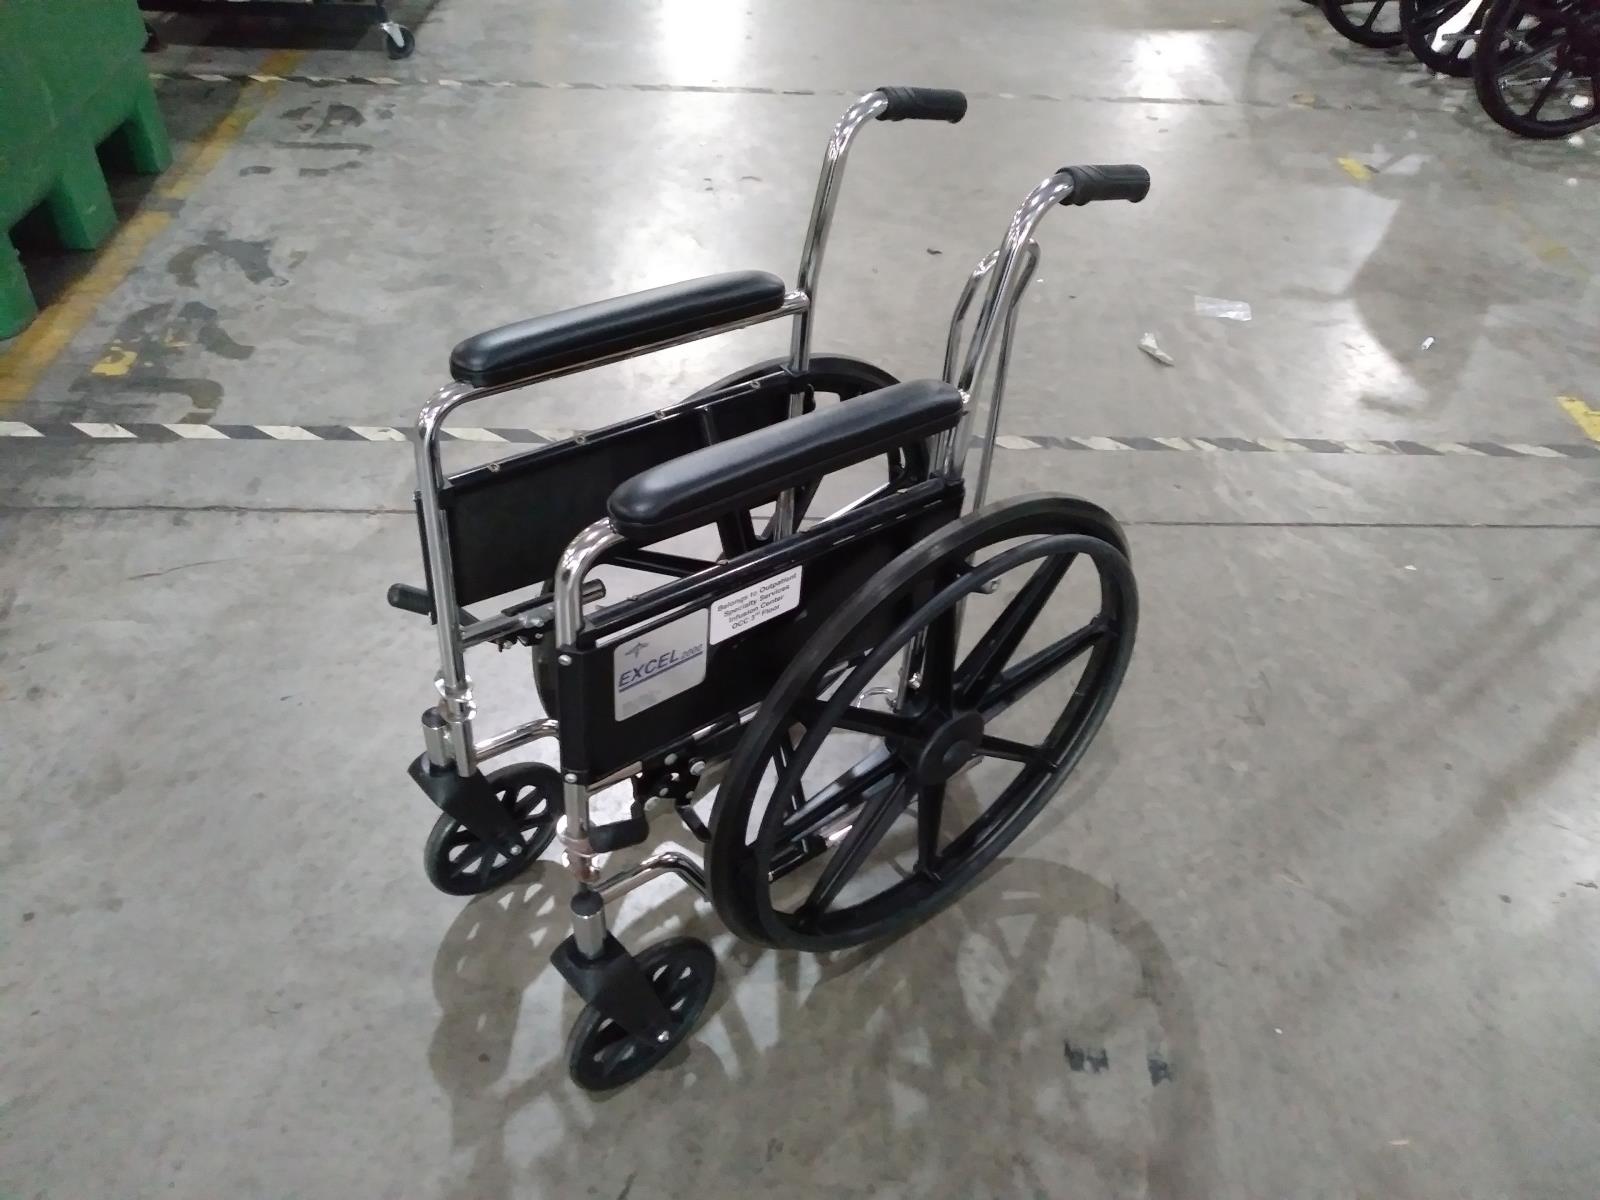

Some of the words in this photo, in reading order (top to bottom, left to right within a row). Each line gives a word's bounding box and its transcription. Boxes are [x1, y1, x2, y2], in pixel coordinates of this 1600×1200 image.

[717, 595, 748, 612] Belongs
[759, 573, 797, 593] Outpatient
[724, 599, 757, 617] Specialty
[759, 584, 790, 601] Services
[729, 606, 759, 623] Infusion
[760, 594, 784, 609] Center
[731, 617, 749, 629] OCC
[761, 604, 780, 616] Floor
[618, 649, 679, 688] EXCEL
